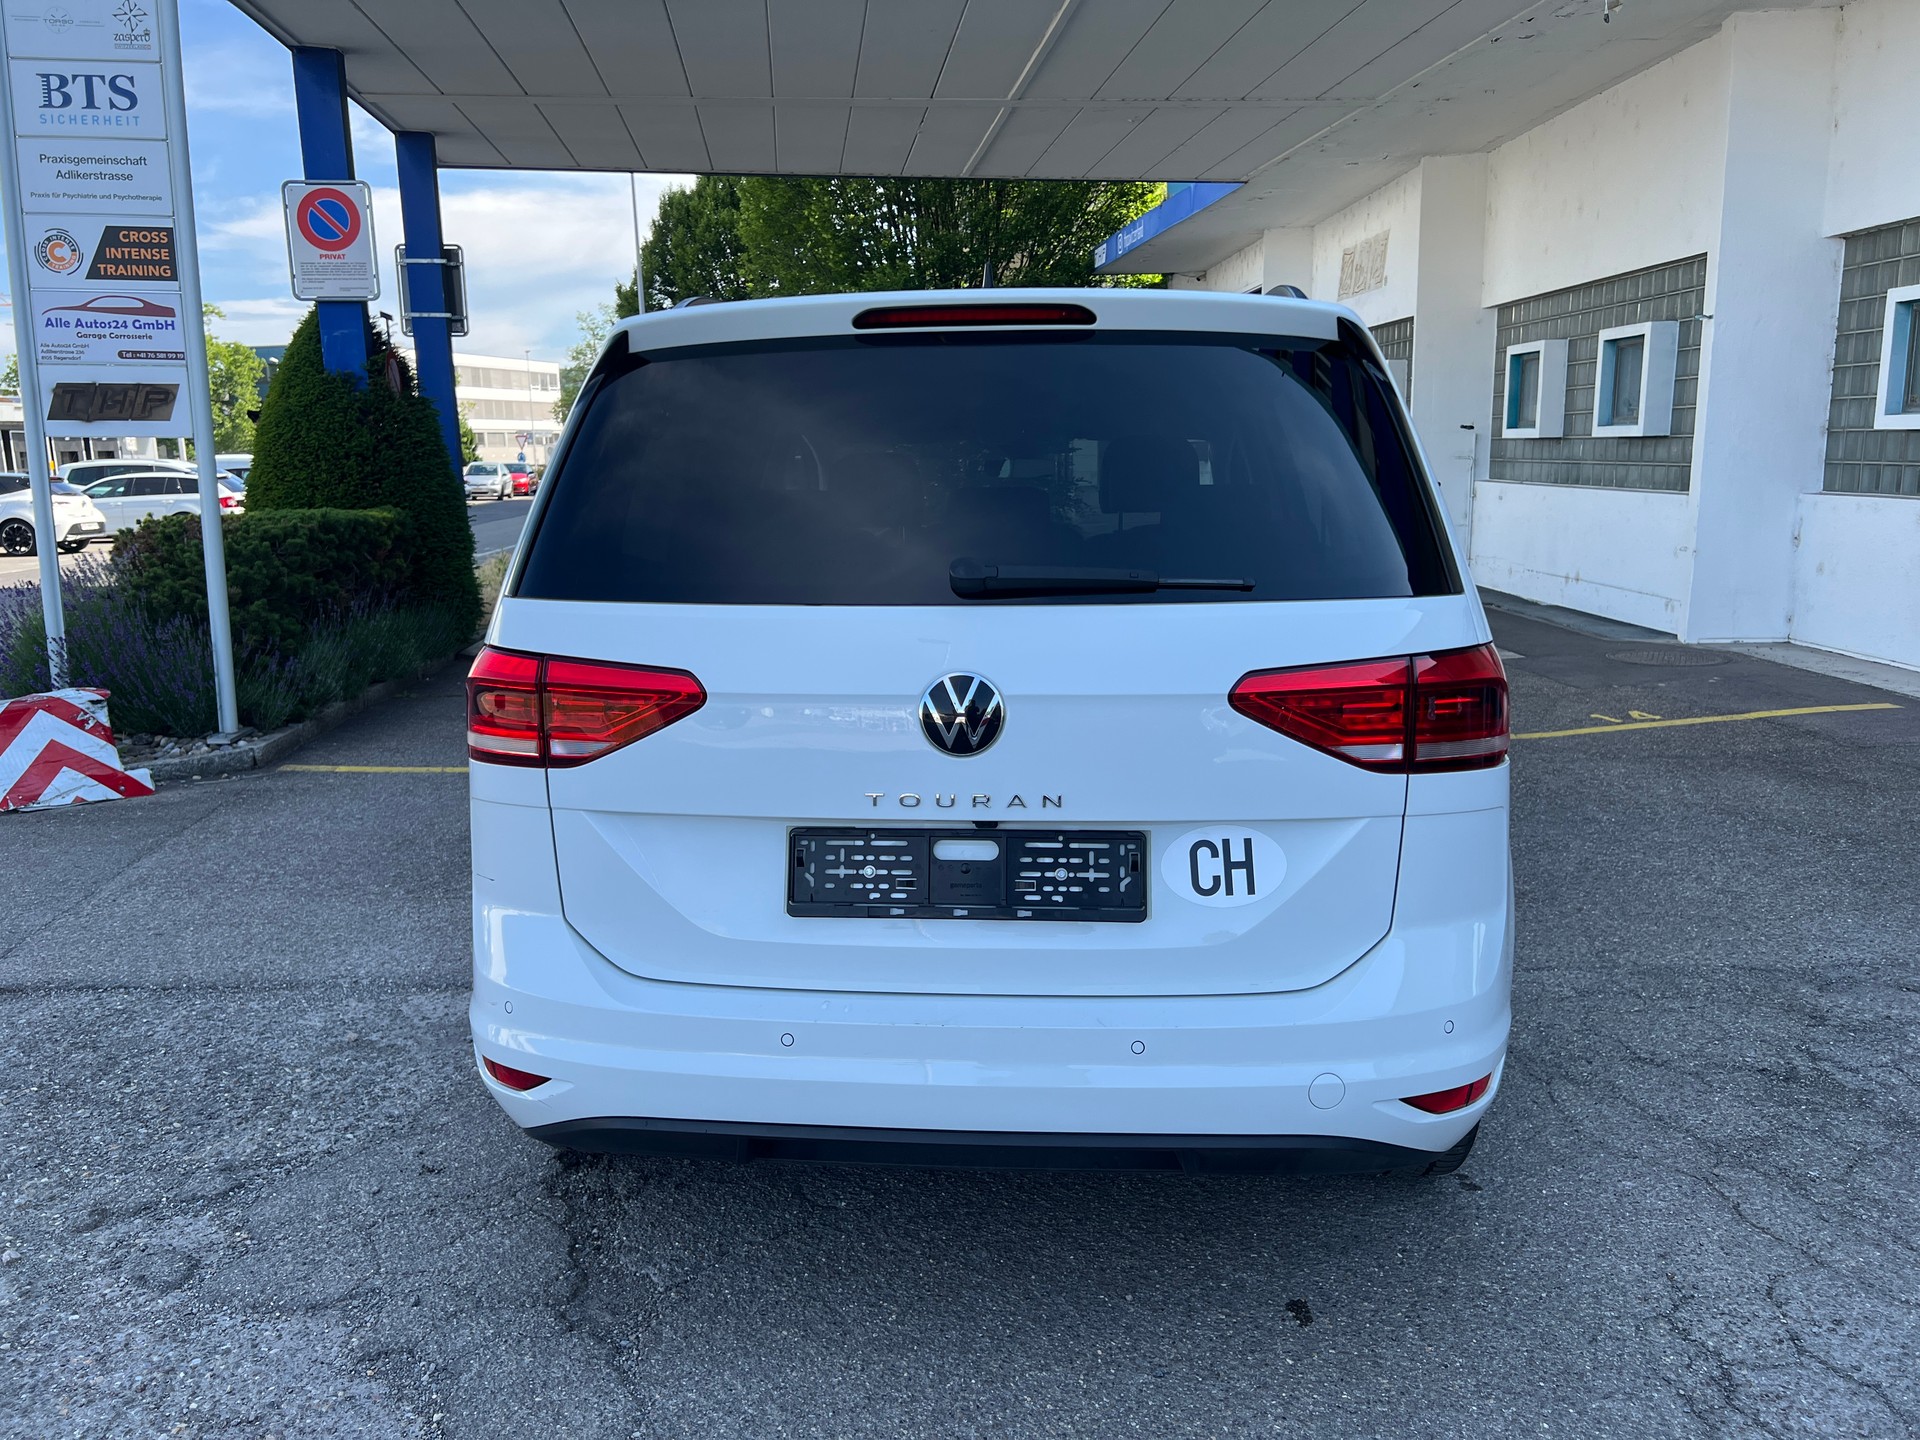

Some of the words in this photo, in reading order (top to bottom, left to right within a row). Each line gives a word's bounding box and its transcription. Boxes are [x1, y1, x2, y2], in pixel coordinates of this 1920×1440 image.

[36, 73, 138, 111] BTS
[39, 114, 140, 126] SICHERHEIT
[39, 154, 147, 166] Praxisgemeinschaft
[56, 170, 133, 181] Adlikerstrasse
[62, 192, 97, 200] Psychiatrie
[113, 194, 162, 202] Psychotherapie
[119, 231, 168, 243] CROSS
[106, 247, 170, 260] INTENSE
[97, 264, 171, 277] TRAINING
[45, 317, 70, 329] Alle
[74, 318, 128, 330] Autos24
[132, 319, 175, 331] GmbH
[76, 331, 107, 340] Garage
[864, 792, 1063, 809] TOURAN
[1189, 837, 1256, 897] CH
